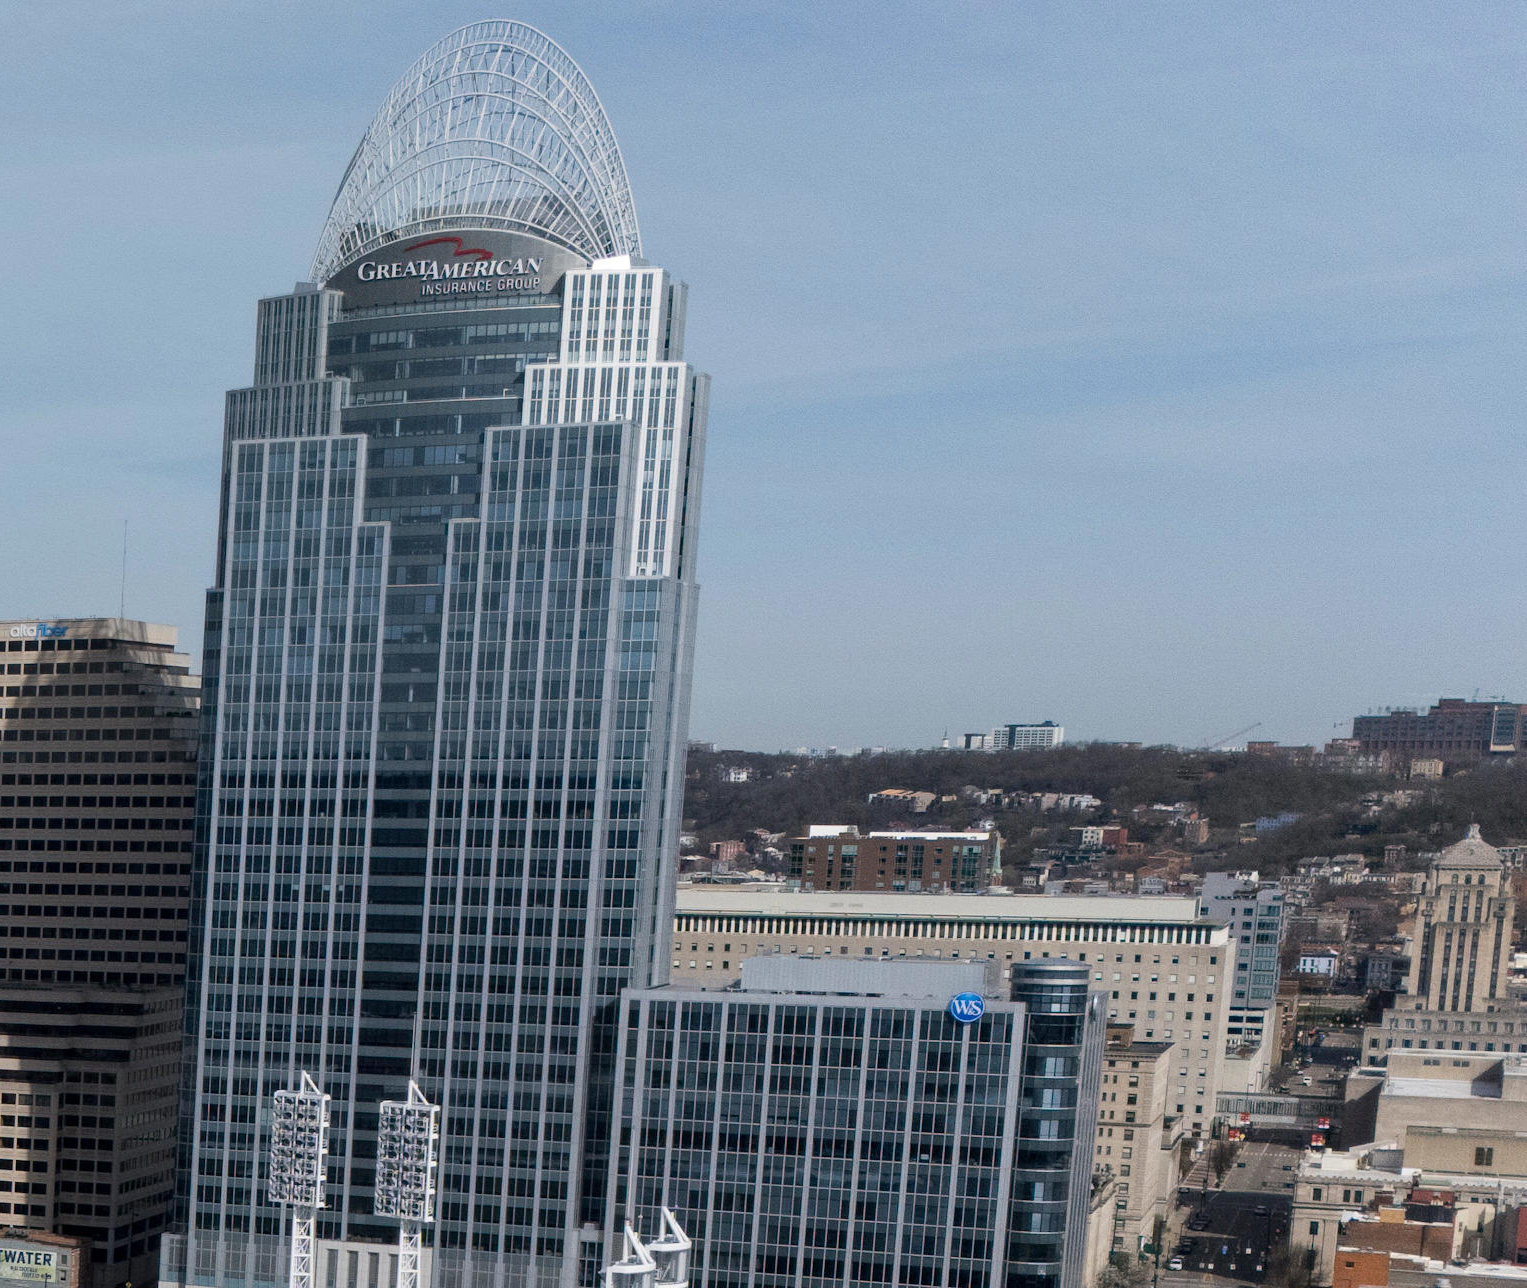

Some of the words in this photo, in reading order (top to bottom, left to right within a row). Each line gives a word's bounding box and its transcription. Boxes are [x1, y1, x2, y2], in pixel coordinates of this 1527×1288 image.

[421, 280, 492, 296] INSURANCE
[497, 277, 541, 291] GROUP
[10, 623, 68, 641] altafiber
[954, 999, 982, 1016] W&S
